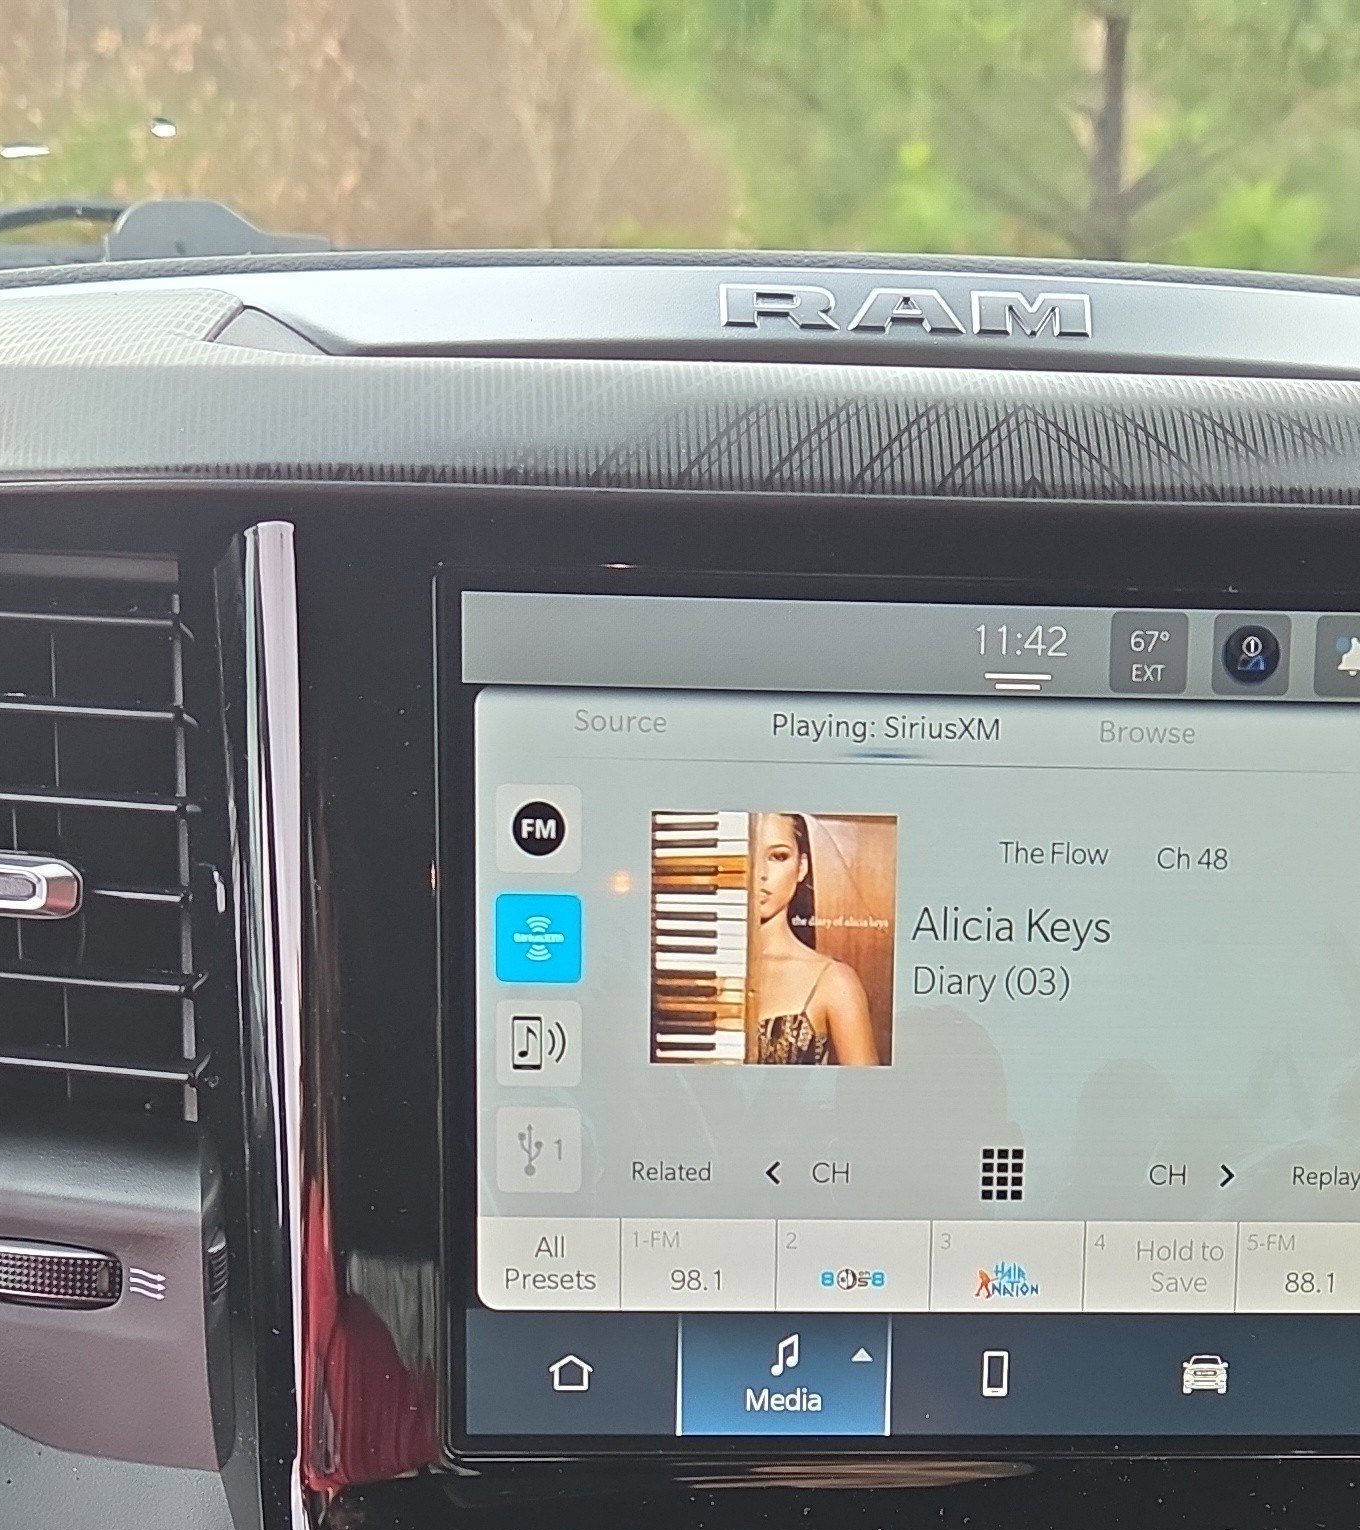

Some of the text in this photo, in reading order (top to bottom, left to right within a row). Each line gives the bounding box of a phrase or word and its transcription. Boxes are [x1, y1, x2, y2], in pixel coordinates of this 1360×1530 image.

[719, 283, 1093, 339] RAM
[976, 624, 1068, 658] 11:42
[1129, 629, 1171, 653] 67°
[1131, 664, 1166, 682] EXT
[574, 709, 668, 734] Source
[772, 713, 1001, 744] Playing: SiriusXM
[1099, 721, 1196, 745] Browse
[520, 818, 557, 840] FM
[1000, 841, 1109, 866] The Flow
[1156, 847, 1229, 871] Ch 48
[911, 906, 1112, 951] Alicia Keys
[913, 965, 1071, 1003] Diary (03)
[553, 1139, 564, 1160] 1
[632, 1160, 713, 1183] Related
[811, 1162, 851, 1184] CH
[1149, 1164, 1187, 1186] CH
[535, 1235, 567, 1259] All
[632, 1230, 681, 1249] 1-FM
[785, 1232, 798, 1250] 2
[940, 1233, 952, 1250] 3
[1094, 1233, 1107, 1251] 4
[1136, 1239, 1224, 1263] Hold to
[1247, 1233, 1296, 1252] 5-FM
[504, 1267, 597, 1293] Presets
[670, 1268, 723, 1292] 98.1
[993, 1261, 1026, 1284] HAIR
[1150, 1272, 1208, 1294] Save
[1284, 1272, 1337, 1295] 88.1
[991, 1280, 1039, 1298] NATION
[745, 1388, 823, 1413] Media
